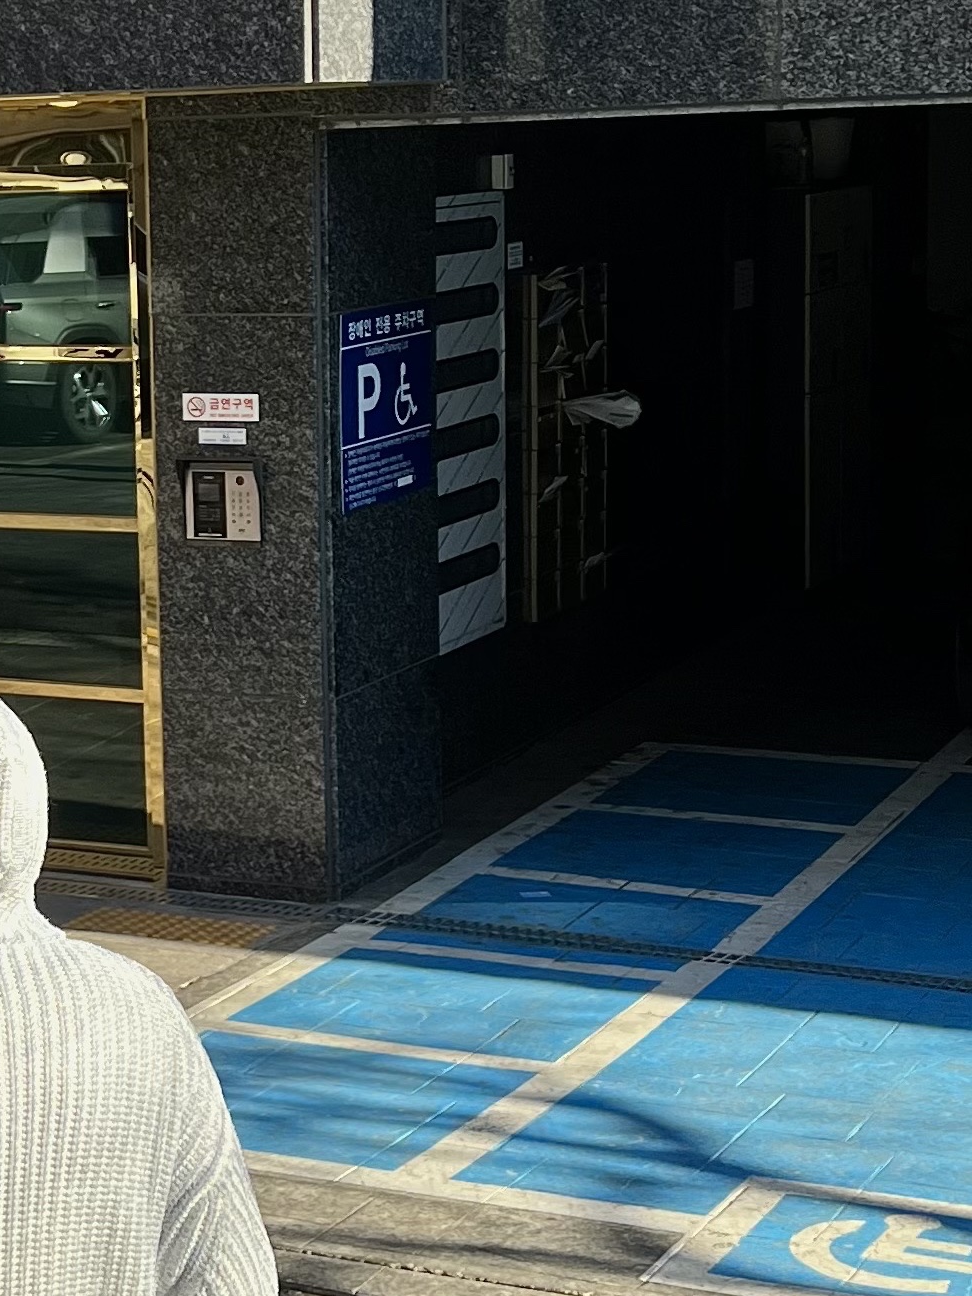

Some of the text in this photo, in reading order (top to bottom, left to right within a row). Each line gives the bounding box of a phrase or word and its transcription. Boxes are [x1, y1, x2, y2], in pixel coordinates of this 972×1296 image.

[348, 309, 425, 341] 장애인 전용 주차구역
[209, 397, 254, 411] 금연구역
[357, 362, 382, 440] P
